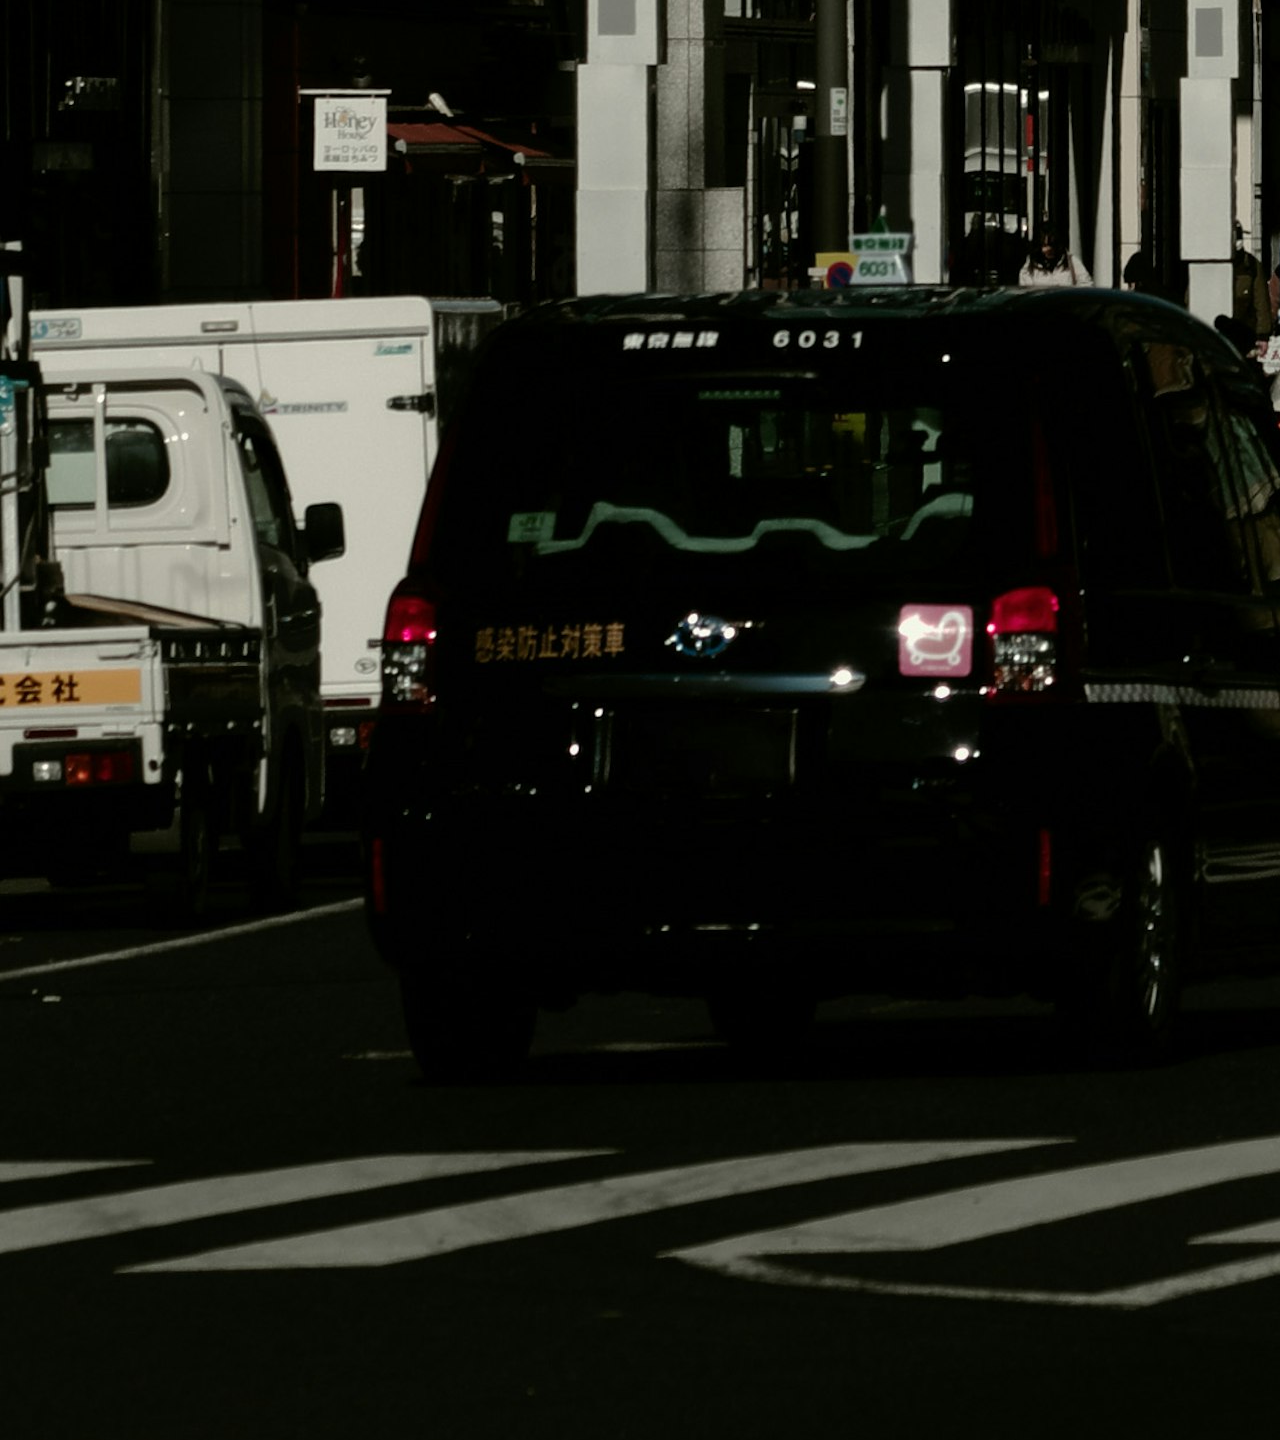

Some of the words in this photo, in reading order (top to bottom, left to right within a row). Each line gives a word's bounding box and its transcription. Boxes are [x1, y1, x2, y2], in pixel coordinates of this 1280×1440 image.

[858, 261, 897, 276] 6031
[771, 329, 864, 350] 6031
[281, 402, 347, 414] TRINITY
[473, 621, 626, 664] 感染防止対策車
[0, 675, 81, 705] 会社
